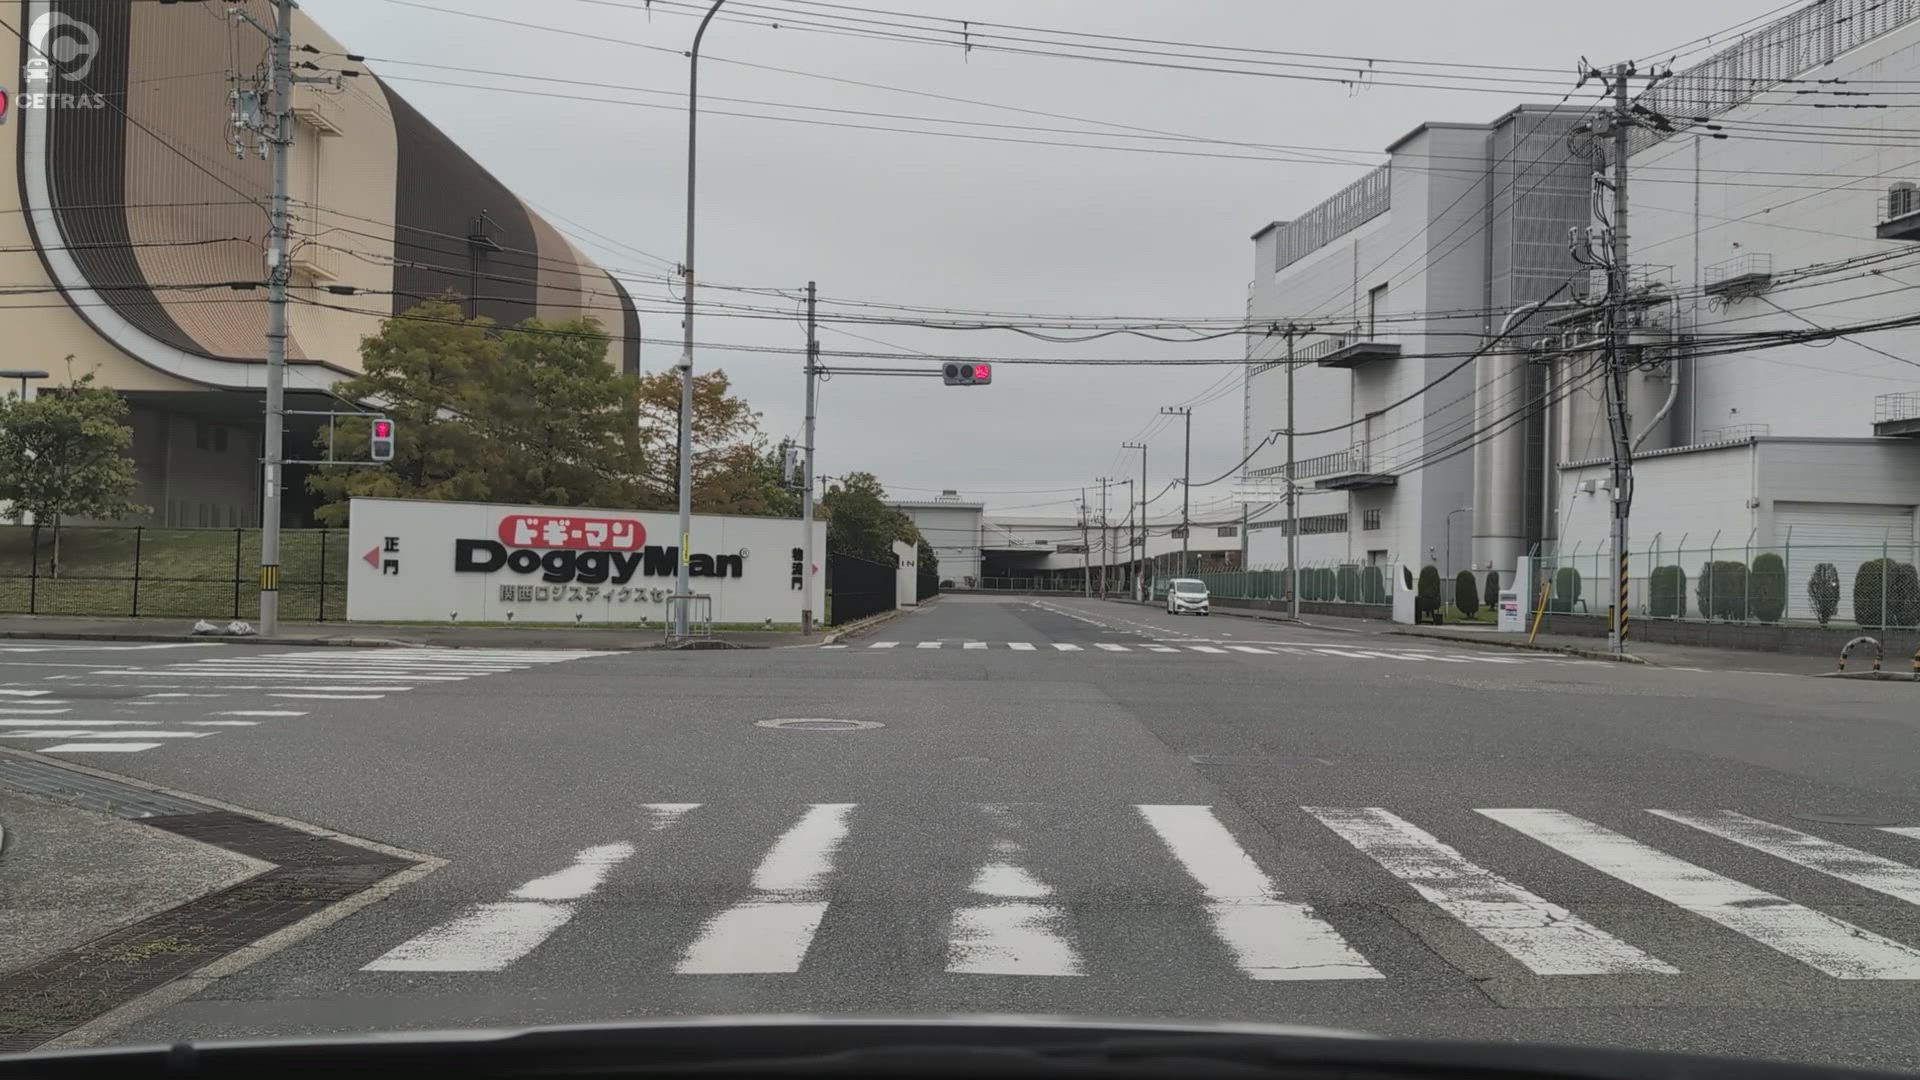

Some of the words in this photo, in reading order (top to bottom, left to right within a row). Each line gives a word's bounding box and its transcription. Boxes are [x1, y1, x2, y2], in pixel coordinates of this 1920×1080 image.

[514, 518, 634, 548] ドギーマン
[383, 537, 400, 575] 正門
